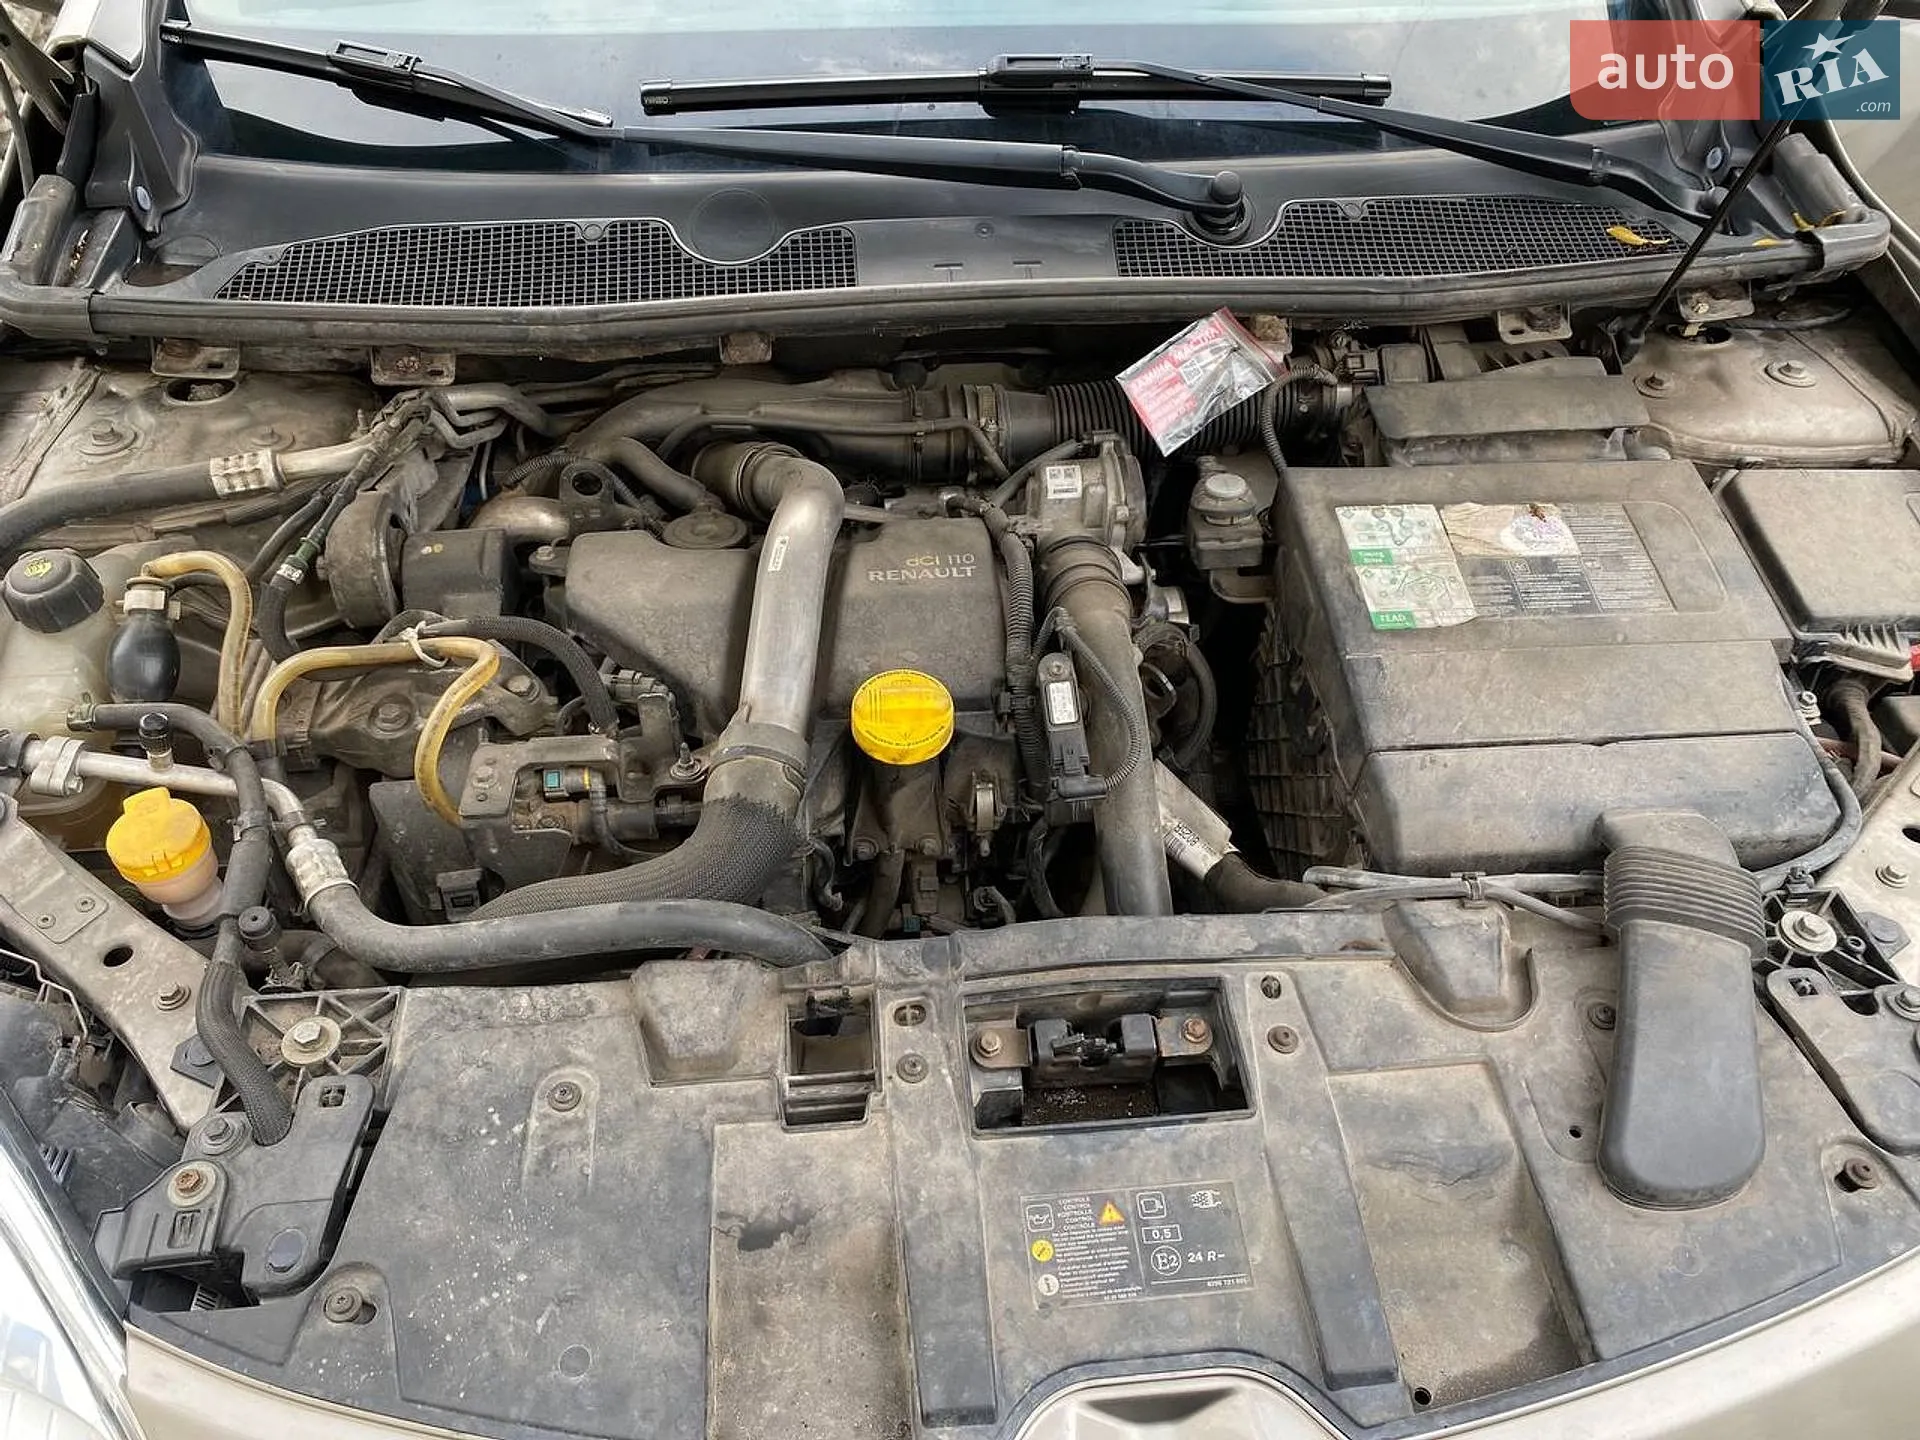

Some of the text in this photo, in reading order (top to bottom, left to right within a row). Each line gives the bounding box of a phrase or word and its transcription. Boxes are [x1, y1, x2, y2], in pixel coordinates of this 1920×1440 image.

[949, 553, 975, 565] 110
[867, 566, 976, 582] RENAULT
[1187, 1251, 1203, 1263] 24
